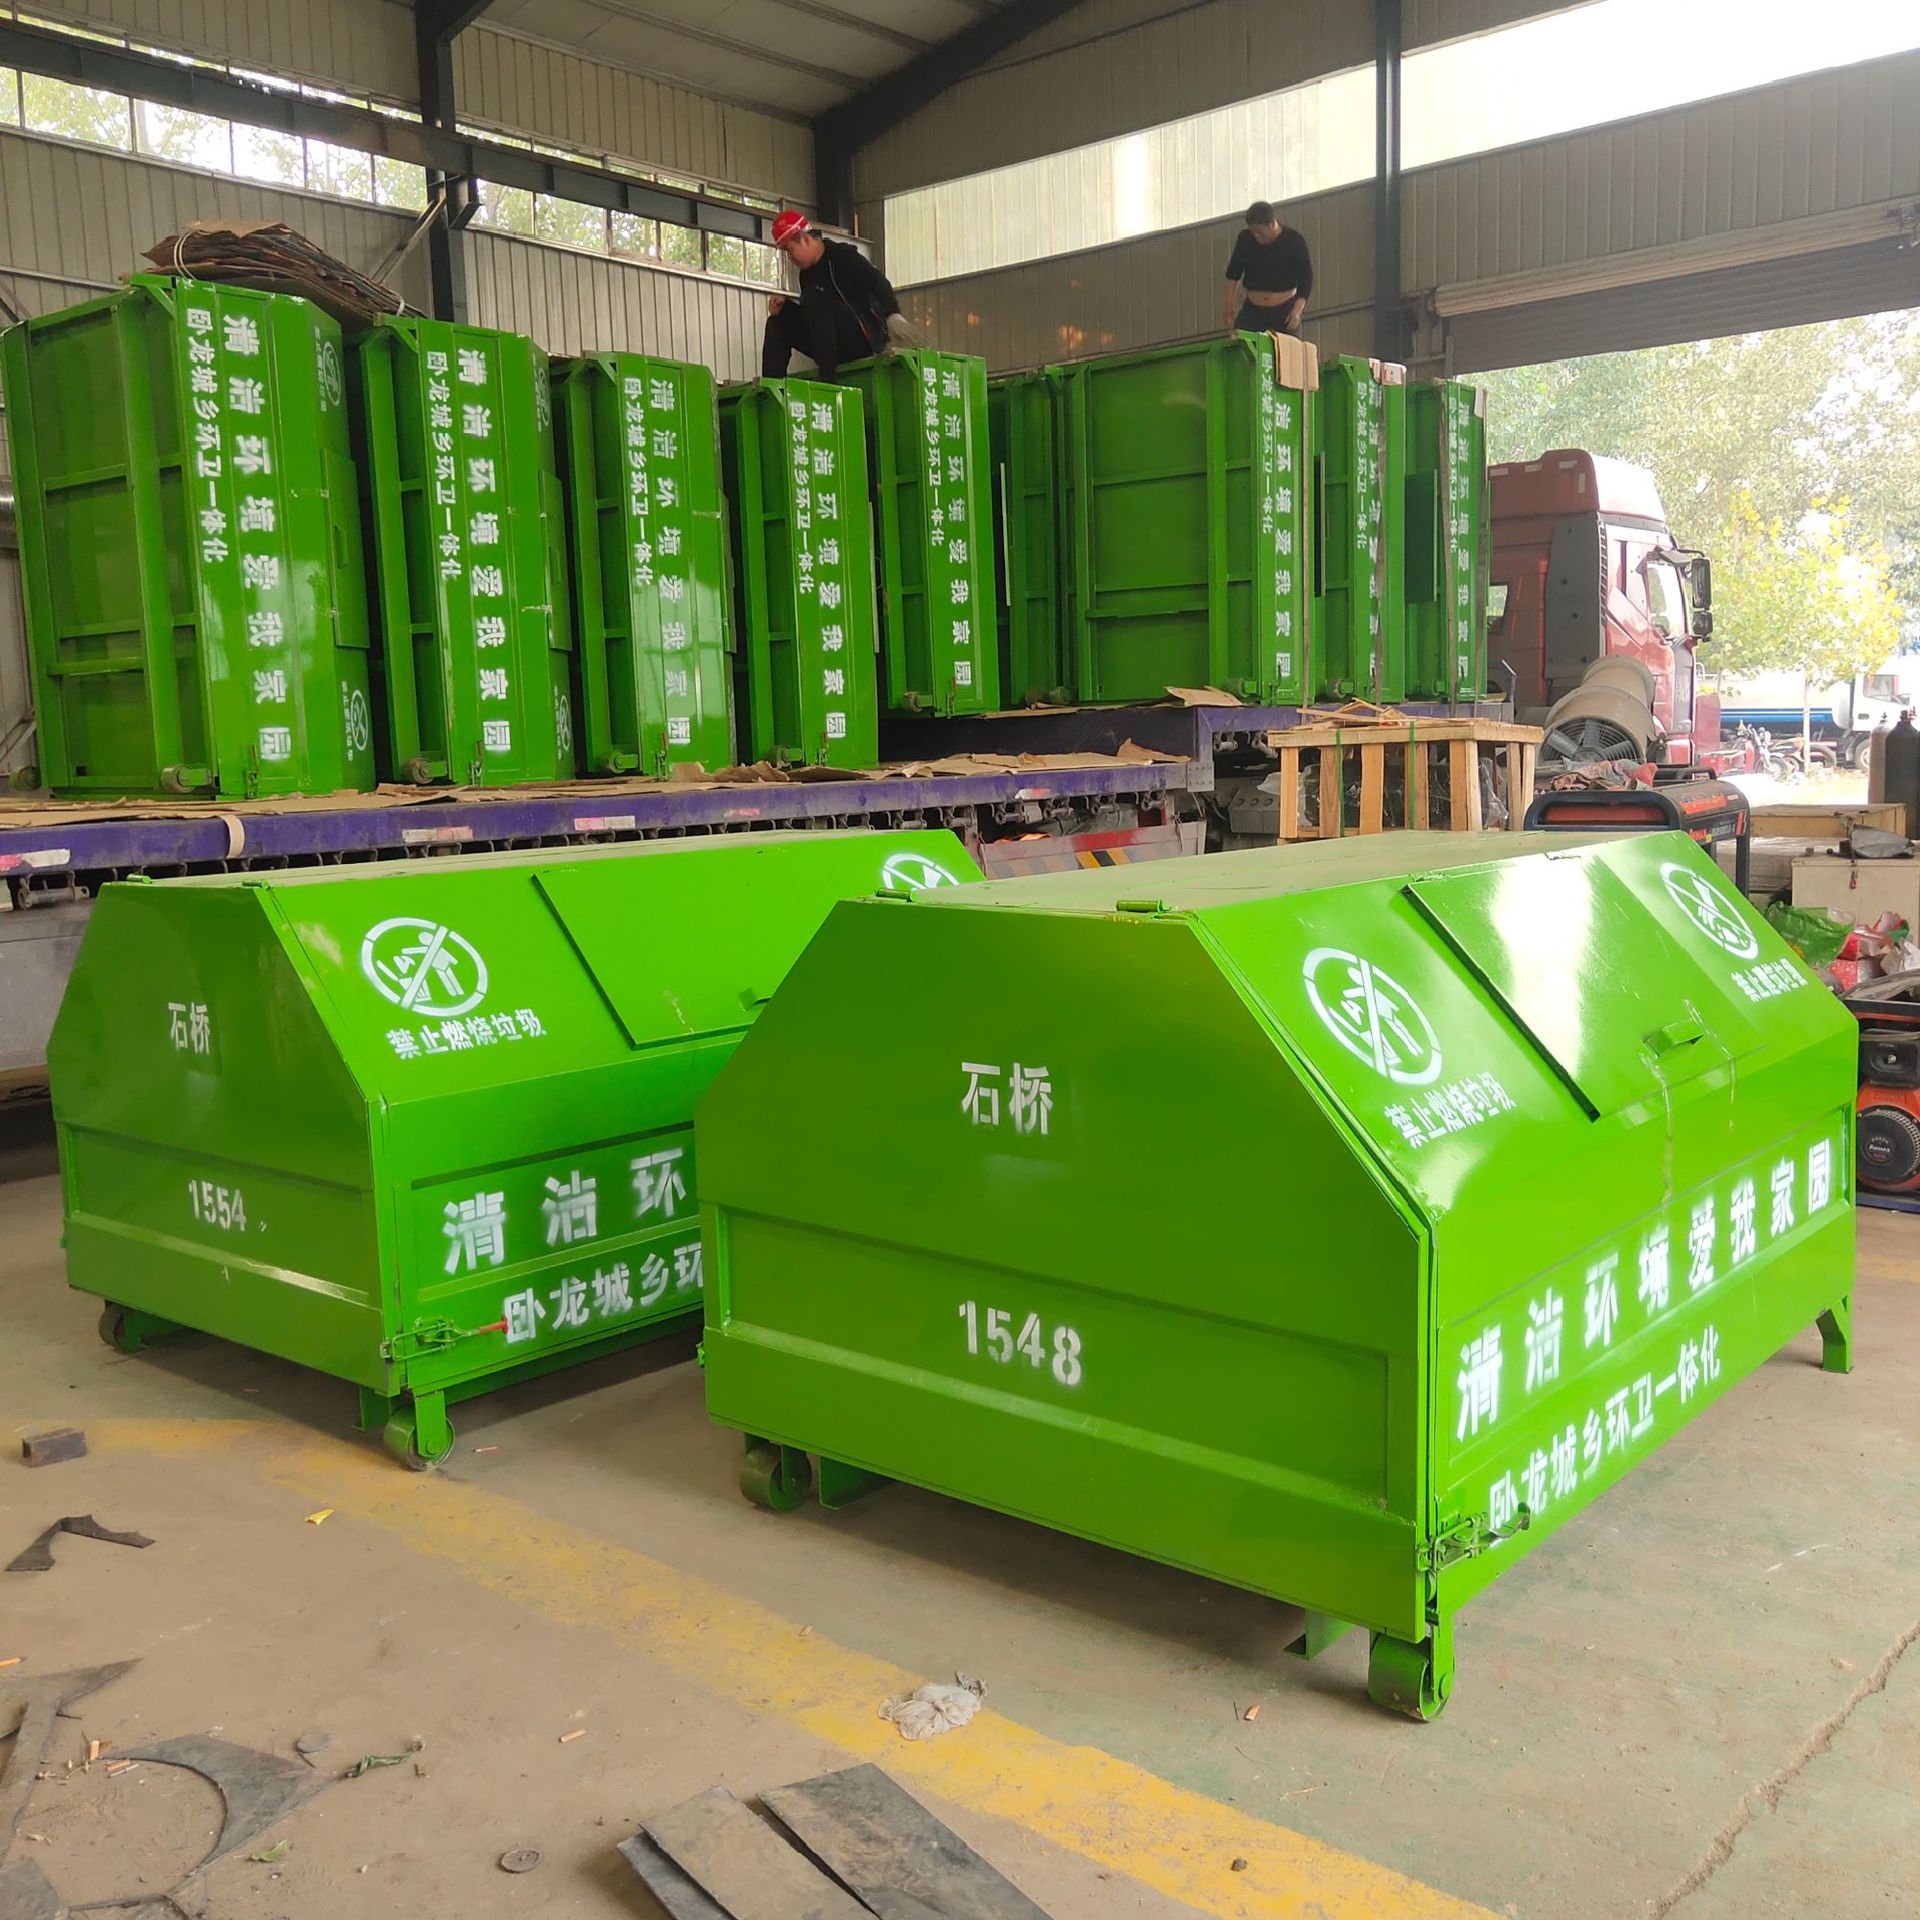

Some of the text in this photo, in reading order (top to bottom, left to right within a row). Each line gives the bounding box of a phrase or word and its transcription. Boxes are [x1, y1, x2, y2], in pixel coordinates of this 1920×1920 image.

[186, 307, 229, 563] 卧龙城乡环卫一体化
[223, 314, 292, 761] 清洁环境爱我家园
[426, 349, 462, 580] 卧龙城乡环卫一体化
[624, 377, 653, 586] 卧龙城乡环卫一体化
[789, 401, 815, 594] 卧龙城乡环卫一体化
[923, 367, 945, 546] 卧龙城乡环卫一体化
[942, 369, 973, 686] 清洁环境爱我家园
[457, 348, 512, 753] 清洁环境爱我家园
[651, 378, 691, 745] 清洁环境爱我家园
[811, 401, 847, 740] 清洁环境爱我家园
[168, 1002, 211, 1055] 石桥
[386, 1008, 547, 1060] 禁止燃烧垃圾
[960, 1062, 1053, 1135] 石桥
[1384, 1071, 1517, 1149] 禁止燃烧垃圾
[188, 1180, 247, 1232] 1554
[1456, 1138, 1831, 1442] 清洁环境爱我家园
[958, 1301, 1082, 1386] 1548
[1489, 1324, 1721, 1530] 卧龙城乡环卫一体化
